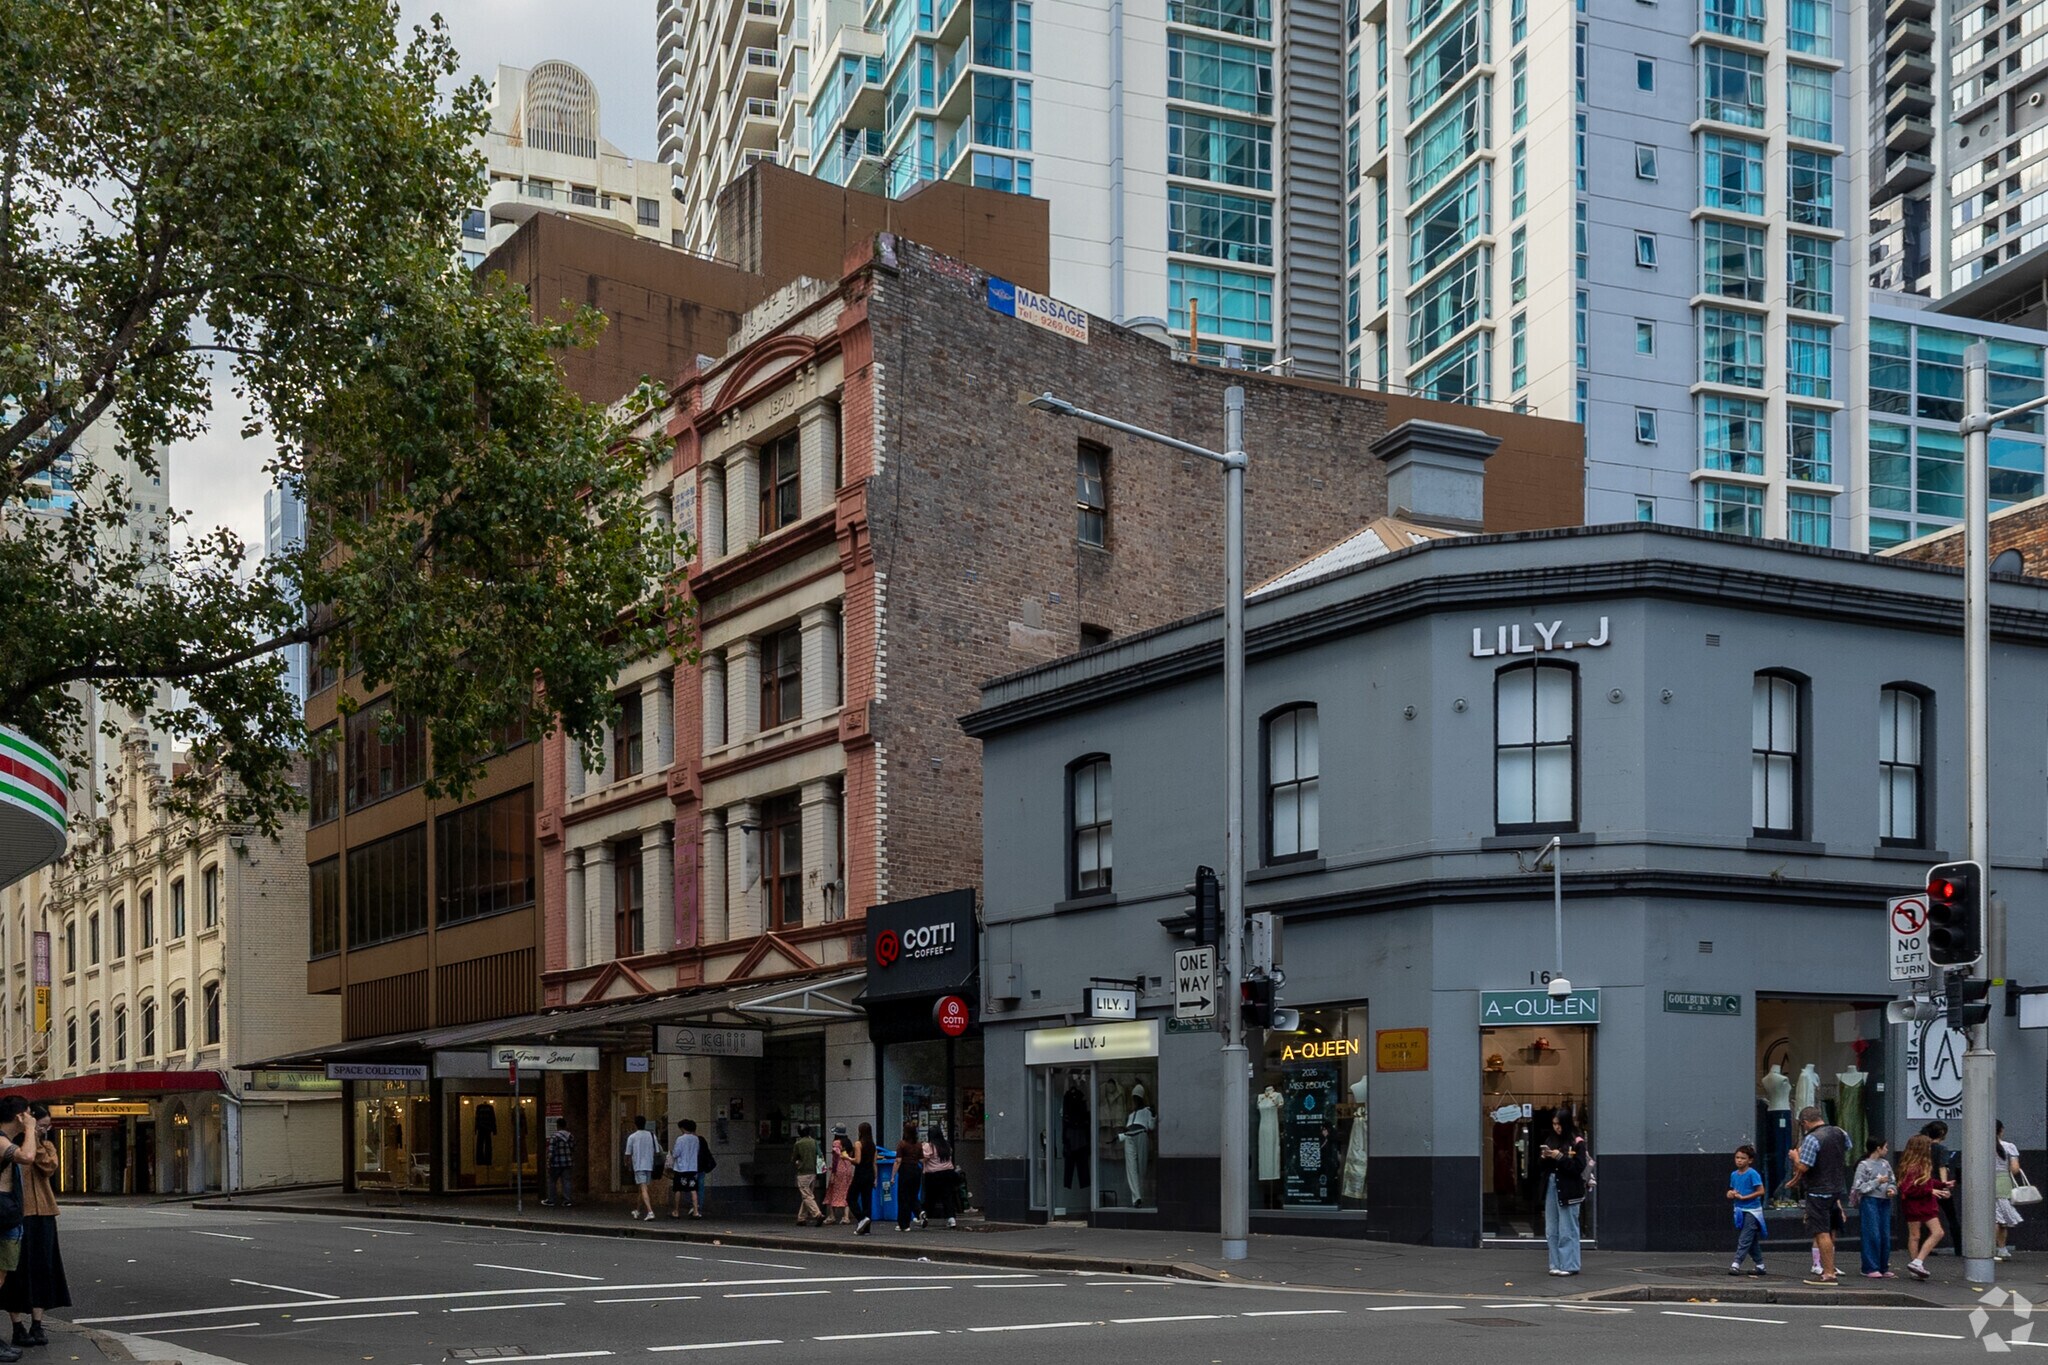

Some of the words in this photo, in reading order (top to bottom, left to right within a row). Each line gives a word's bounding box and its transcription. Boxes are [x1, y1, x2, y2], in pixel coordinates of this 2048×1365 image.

[1018, 290, 1085, 328] MASSAGE
[1041, 316, 1063, 331] 9269
[1065, 324, 1086, 340] 0928
[1473, 620, 1574, 656] LILY.
[1587, 616, 1609, 647] J
[904, 922, 955, 949] COTTI
[1898, 938, 1920, 951] NO
[915, 946, 944, 958] COFFEE
[1896, 953, 1923, 964] LEFT
[1180, 954, 1208, 971] ONE
[1895, 964, 1925, 975] TURN
[1179, 975, 1210, 993] WAY
[1097, 997, 1121, 1010] LILY.
[1124, 999, 1130, 1011] J
[1668, 994, 1710, 1005] GOULBURN
[1712, 996, 1722, 1006] ST
[1485, 998, 1596, 1017] A-QUEEN
[943, 1016, 964, 1024] COTTI
[1074, 1037, 1097, 1050] LILY.
[1100, 1036, 1106, 1048] J
[1282, 1038, 1359, 1061] A-QUEEN
[516, 1050, 541, 1061] From
[546, 1051, 576, 1064] Seoul
[334, 1066, 363, 1075] SPACE
[365, 1066, 422, 1076] COLLECTION
[1912, 1084, 1932, 1114] NEO
